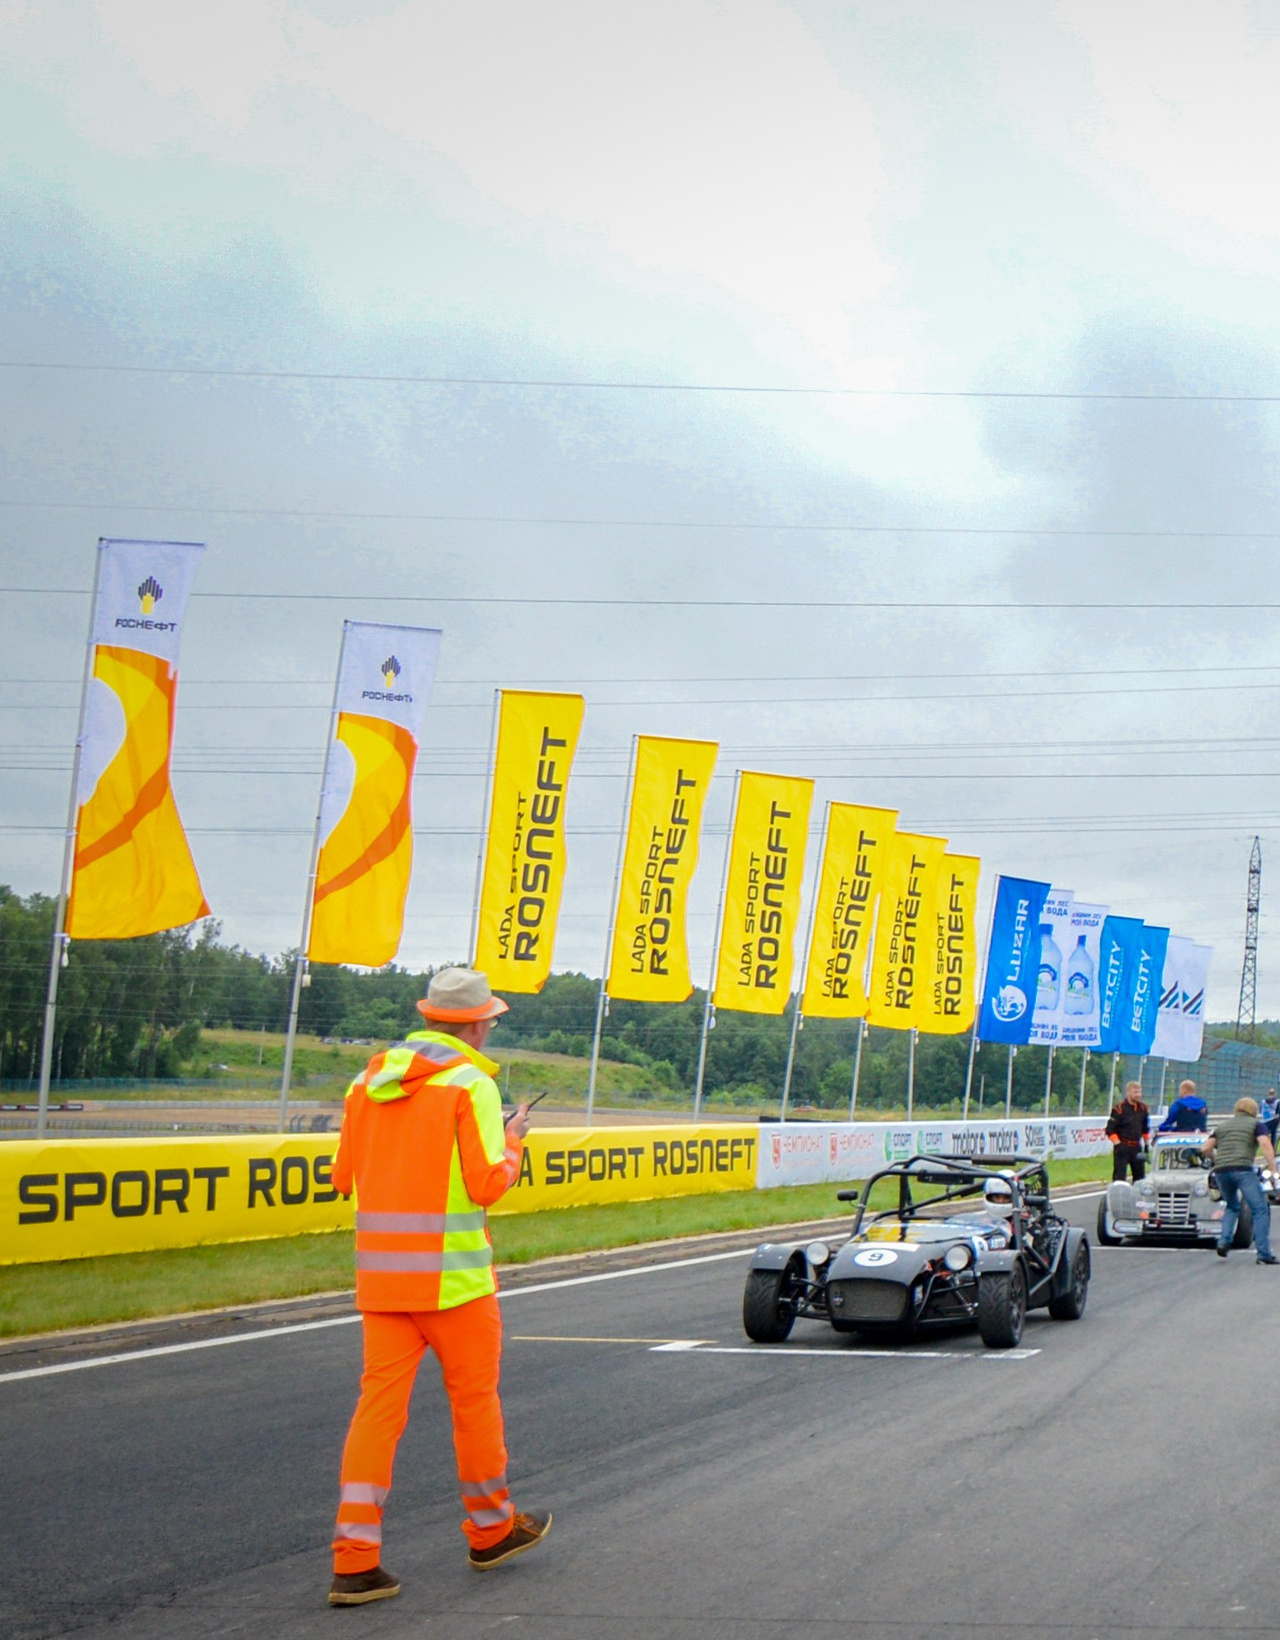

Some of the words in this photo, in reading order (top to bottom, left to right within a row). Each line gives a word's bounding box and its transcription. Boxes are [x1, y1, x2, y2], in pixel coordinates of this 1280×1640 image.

[115, 618, 178, 632] РОСНЕФТ
[498, 904, 516, 959] LADA
[510, 791, 528, 894] SPORT
[514, 726, 567, 961] ROSNEFT
[650, 769, 697, 976] ROSNEFT
[631, 923, 647, 973] LADA
[639, 825, 664, 915] SPORT
[745, 851, 762, 934] SPORT
[755, 801, 791, 989] ROSNEFT
[832, 830, 877, 999] ROSNEFT
[889, 897, 904, 964] SPORT
[895, 854, 926, 1010] ROSNEFT
[738, 941, 754, 986] LADA
[822, 957, 836, 998] LADA
[831, 876, 849, 950] SPORT
[936, 912, 945, 975] SPORT
[944, 873, 965, 1016] ROSNEFT
[1007, 899, 1030, 981] LUZAR
[884, 970, 896, 1007] LADA
[934, 980, 943, 1015] LADA
[1102, 940, 1123, 1028] BETCITY
[1131, 949, 1152, 1032] BETCITY
[18, 1166, 230, 1225] SPORT
[247, 1155, 352, 1209] ROS
[545, 1147, 645, 1185] SPORT
[652, 1138, 755, 1177] ROSNEFT
[868, 1252, 883, 1261] 9
